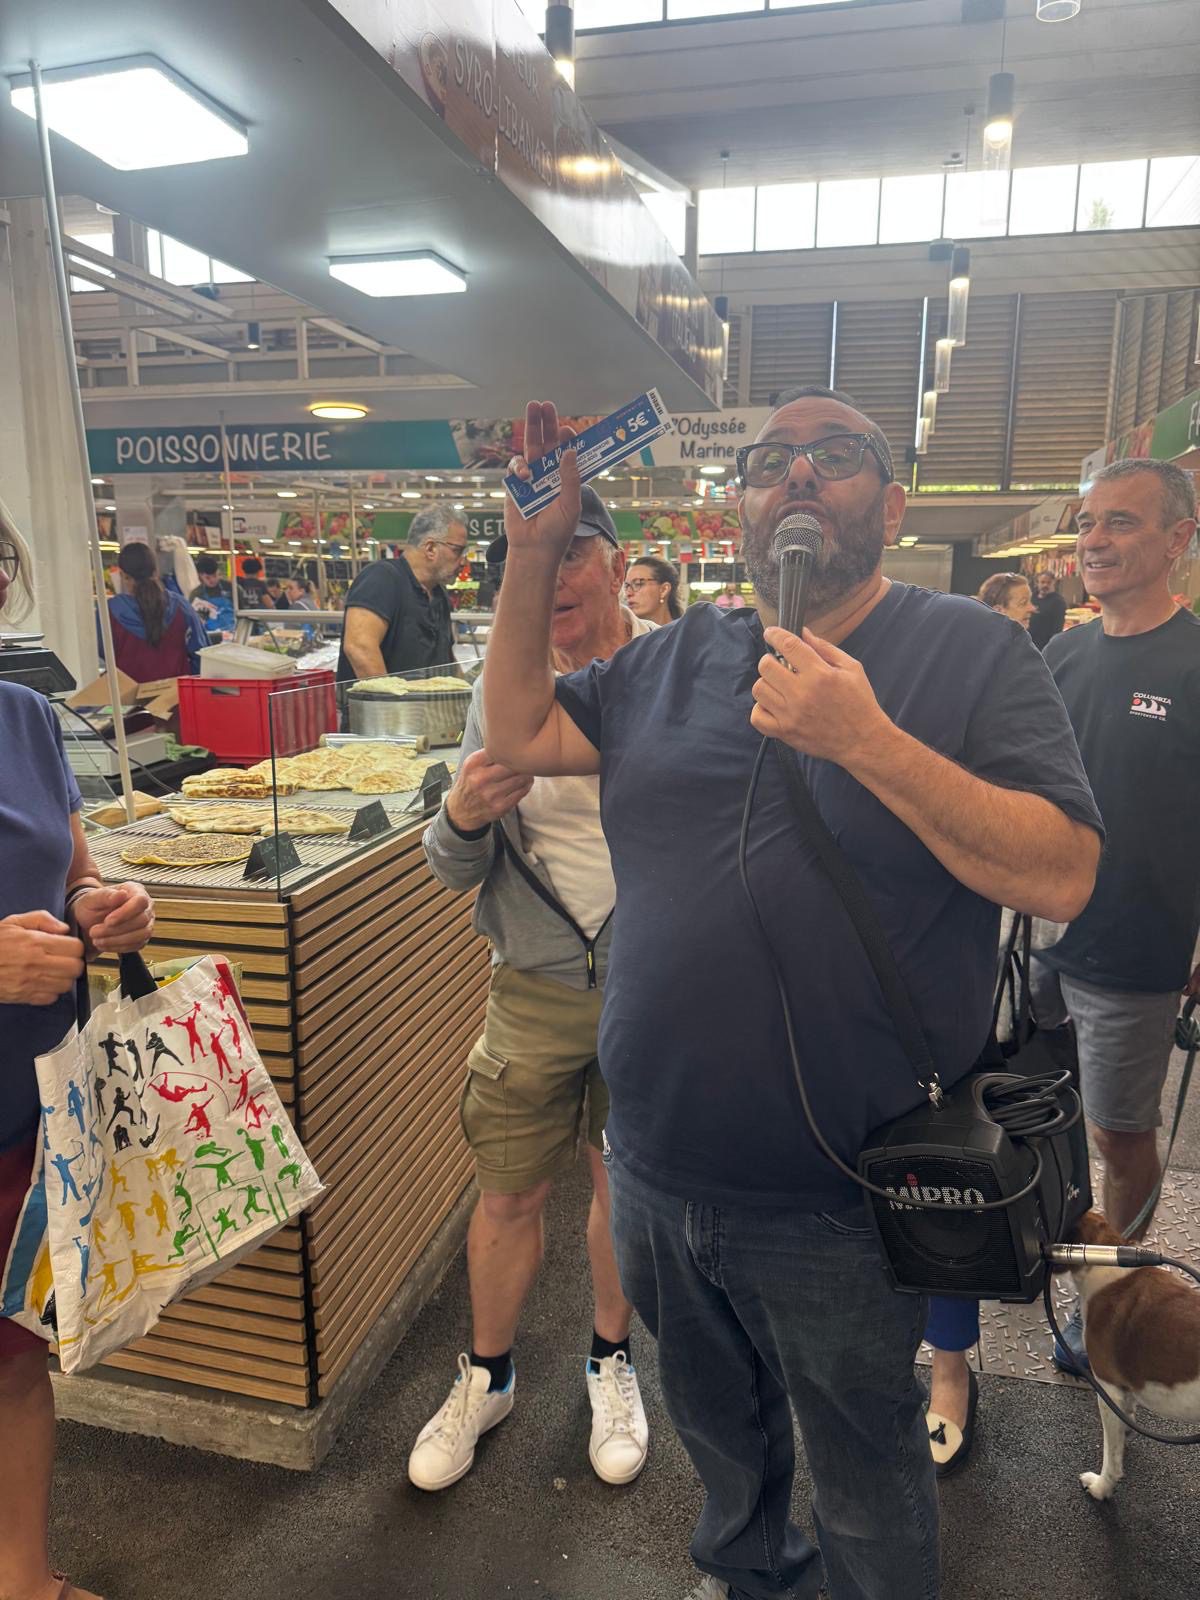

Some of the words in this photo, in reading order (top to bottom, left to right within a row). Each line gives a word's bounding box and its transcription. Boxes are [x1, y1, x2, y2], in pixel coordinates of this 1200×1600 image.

[455, 39, 553, 186] SYRO-LIBANAIS
[627, 411, 649, 432] 5€
[116, 431, 332, 465] POISSONNERIE
[680, 440, 735, 459] Marine
[541, 456, 555, 471] La
